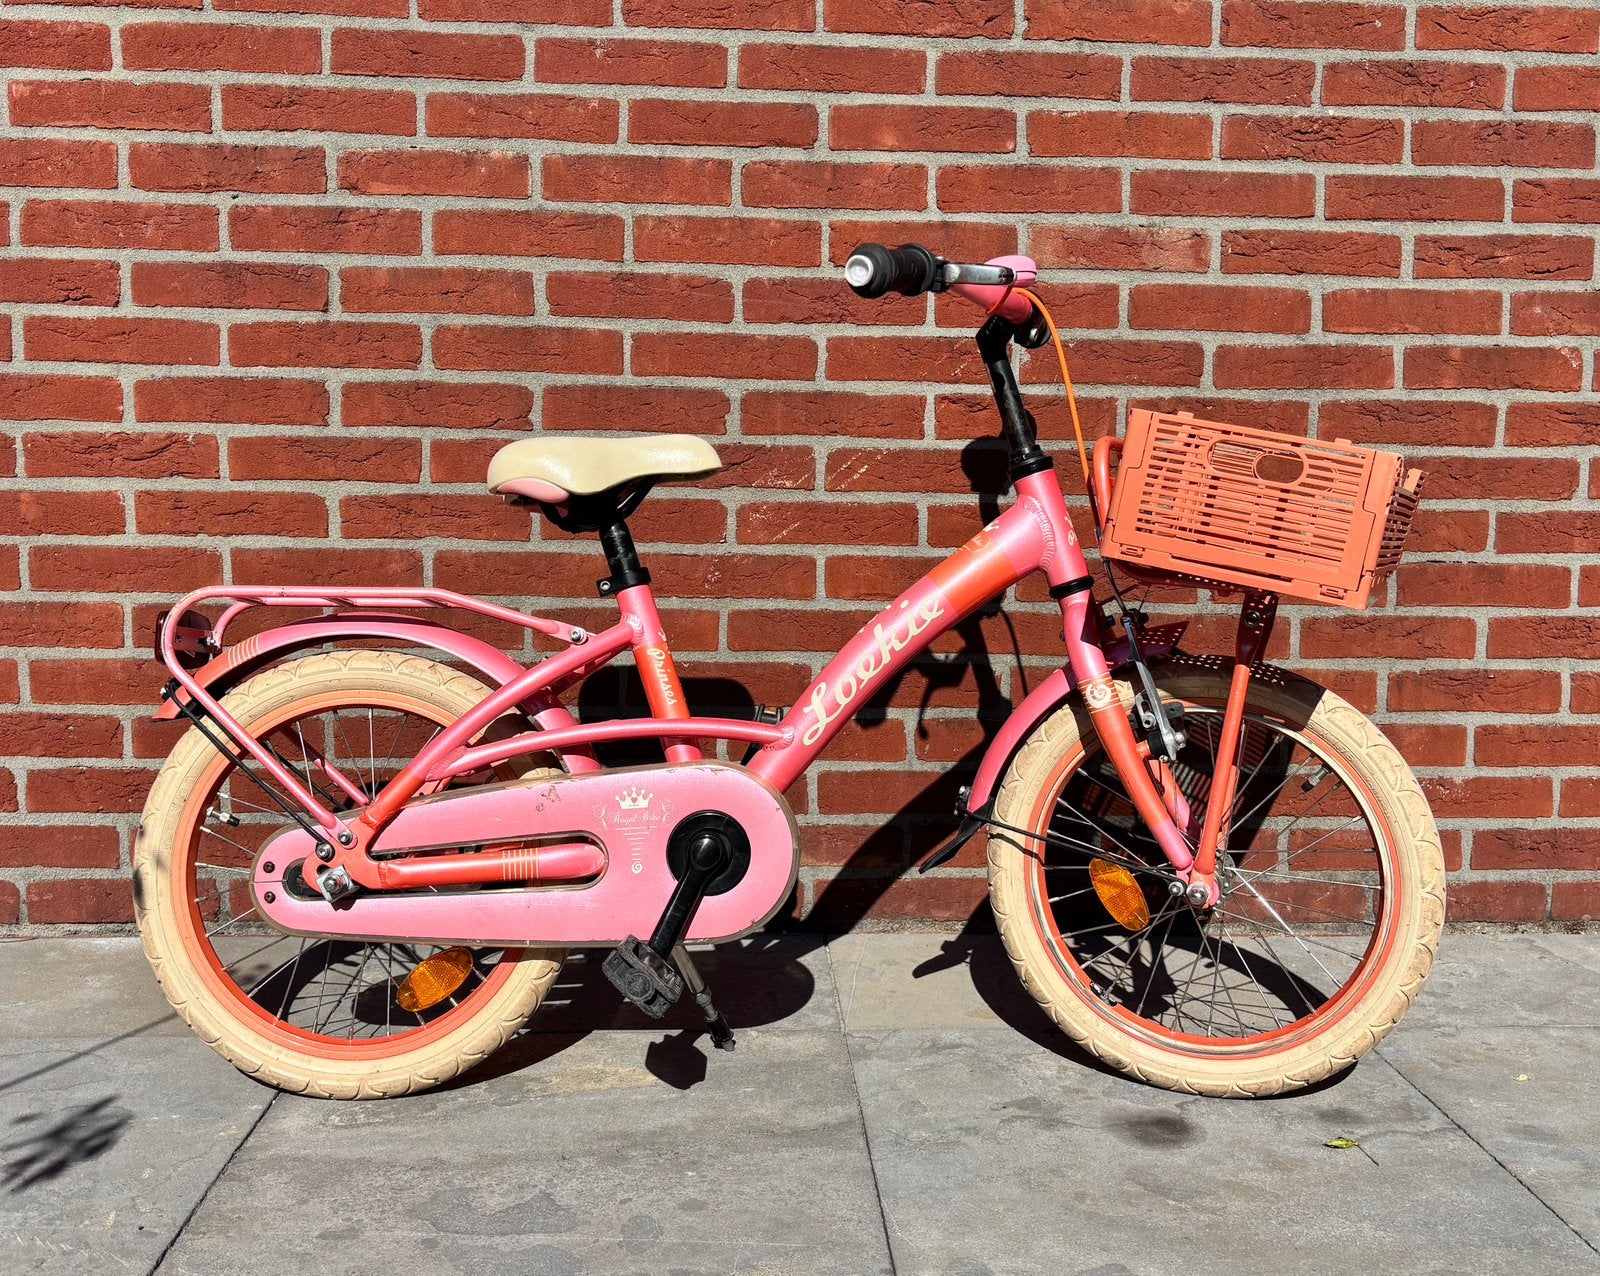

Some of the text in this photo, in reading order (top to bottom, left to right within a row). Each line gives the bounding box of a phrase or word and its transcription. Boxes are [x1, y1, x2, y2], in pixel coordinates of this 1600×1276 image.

[646, 648, 677, 705] Prinses
[803, 596, 944, 746] Loekie
[608, 811, 660, 826] Royal Bike
